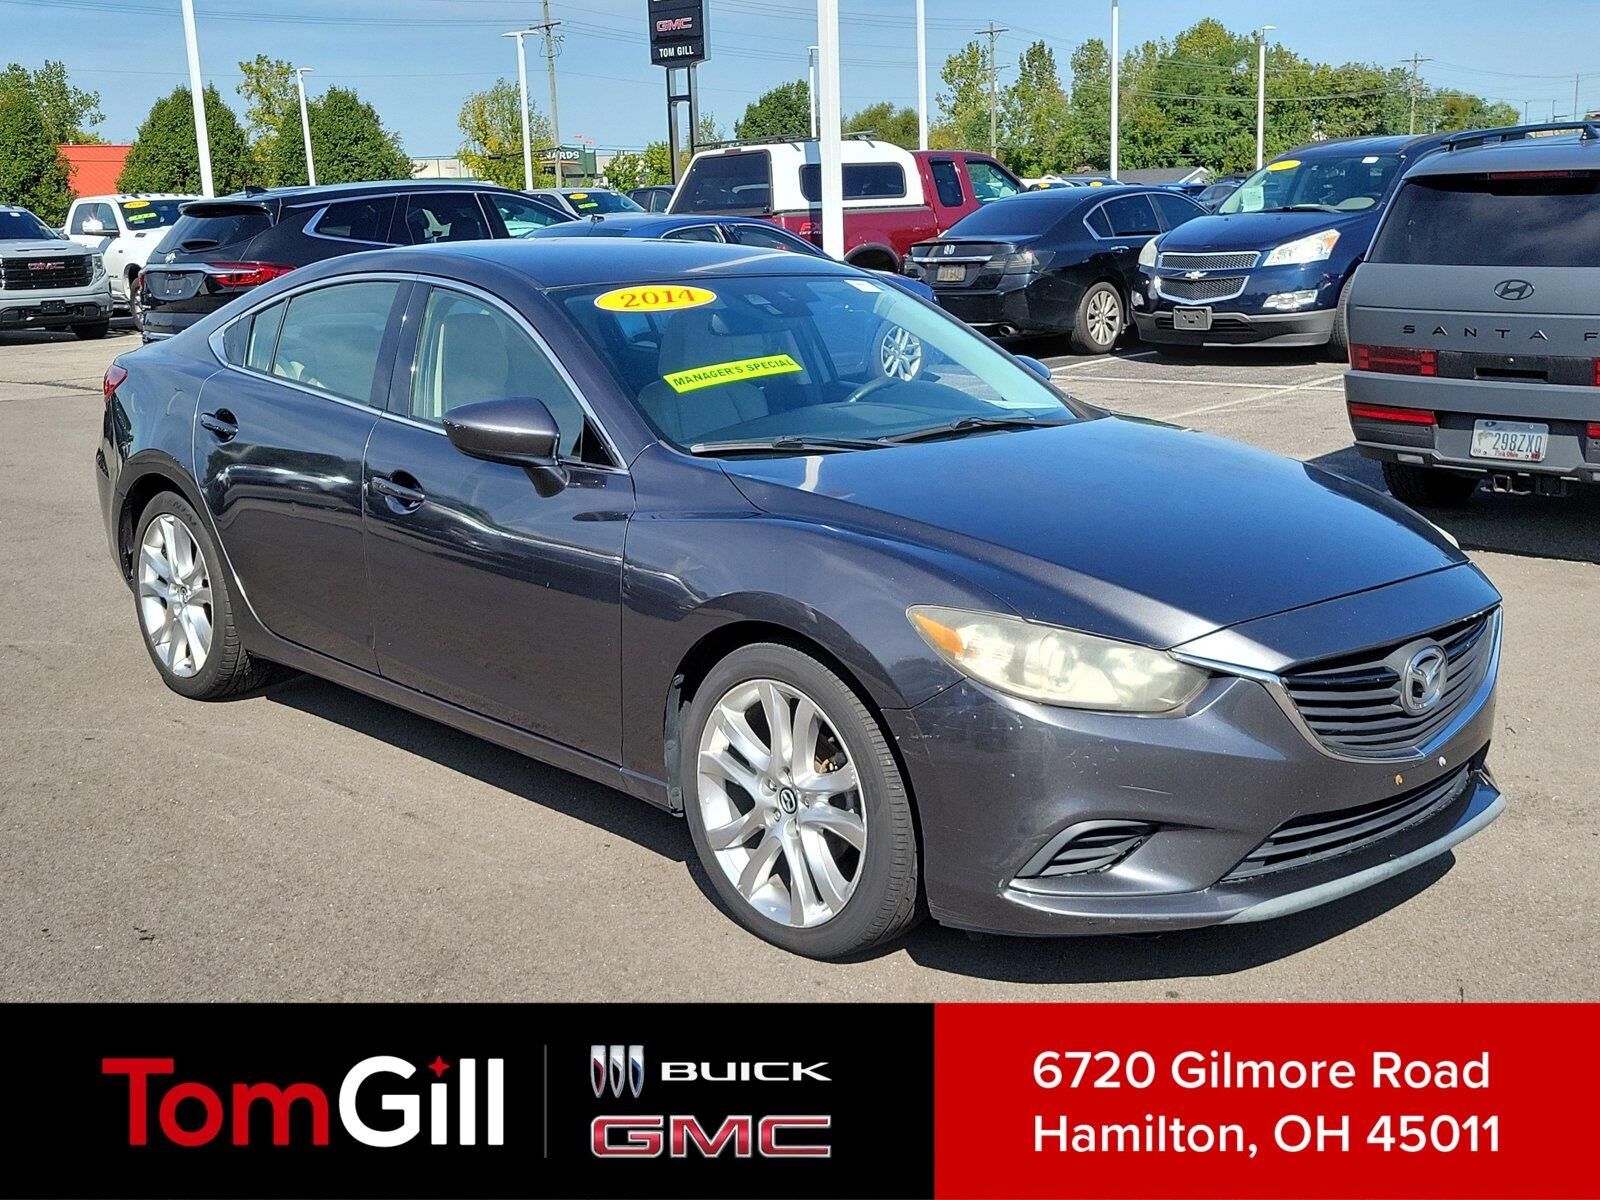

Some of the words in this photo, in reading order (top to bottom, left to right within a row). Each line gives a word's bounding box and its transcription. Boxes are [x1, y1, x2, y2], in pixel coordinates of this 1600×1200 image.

[656, 17, 693, 32] GMC
[659, 47, 675, 58] TOM
[677, 46, 694, 56] GILL
[620, 289, 696, 308] 2014
[1402, 325, 1548, 341] SANTA
[1584, 332, 1599, 341] F
[672, 366, 744, 387] MANAGER'S
[746, 358, 795, 373] SPECIAL
